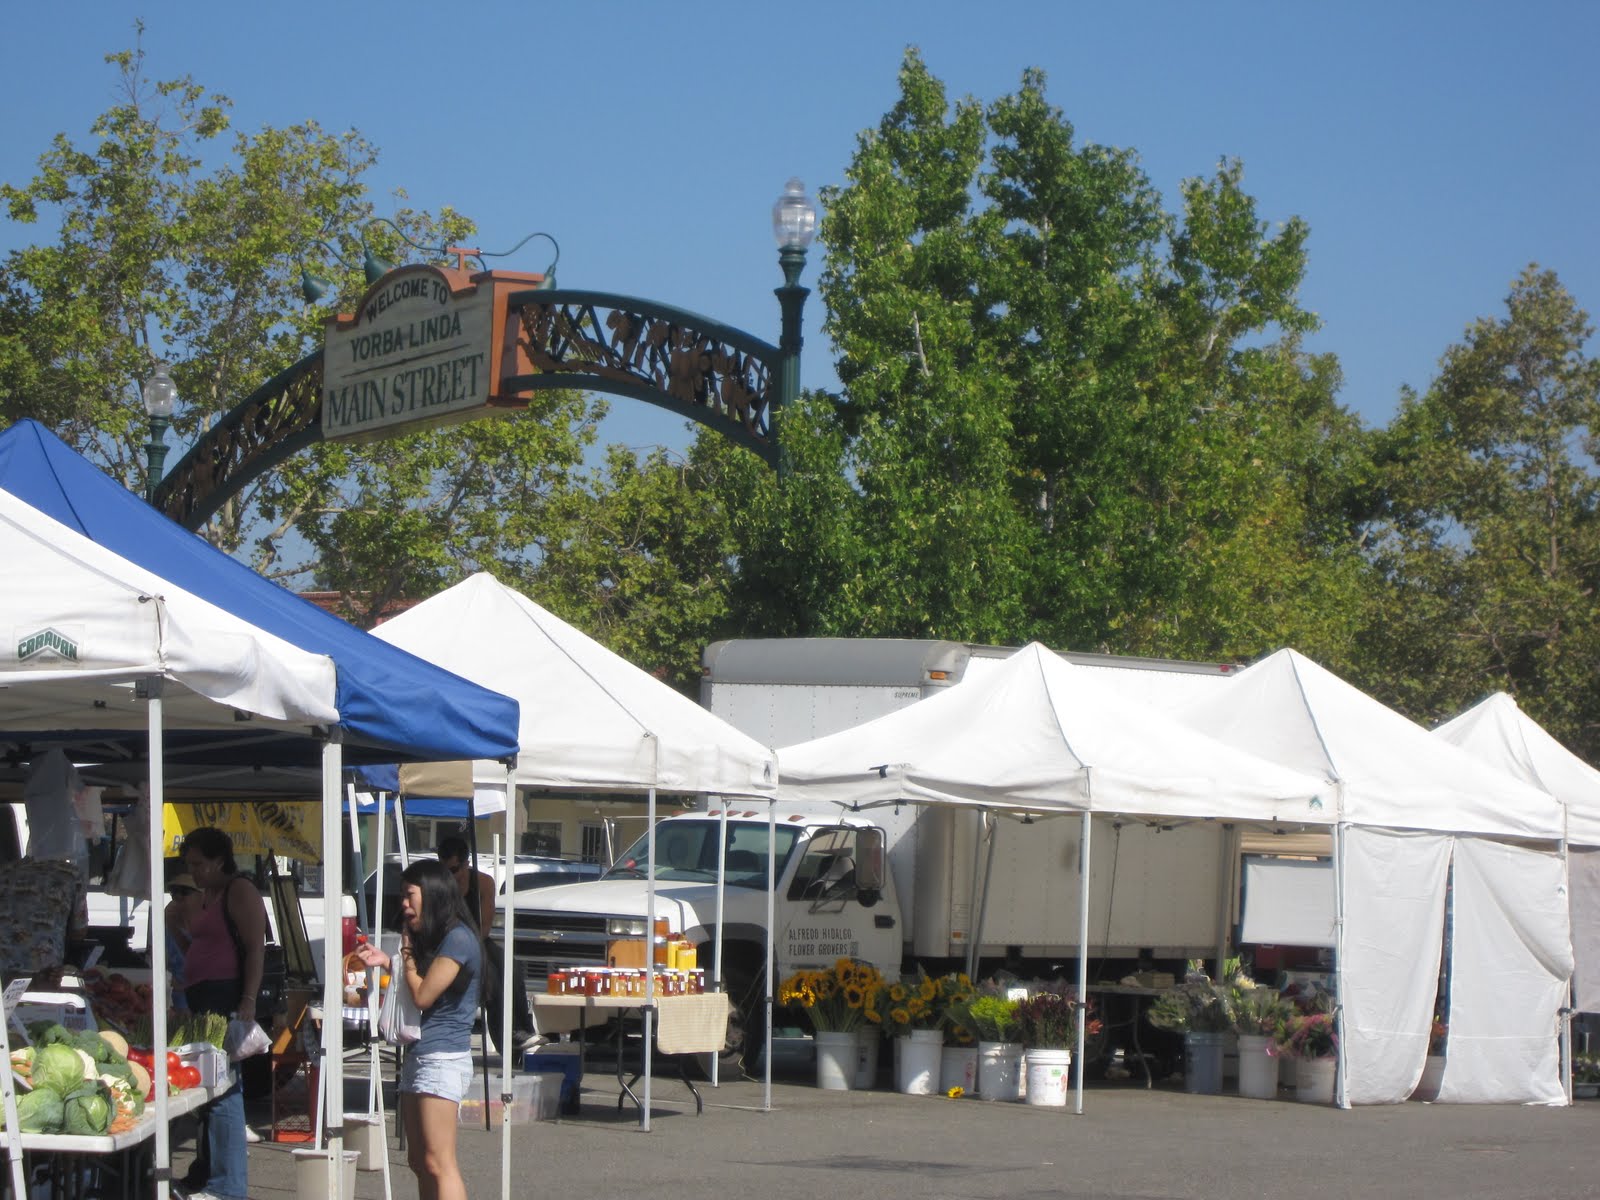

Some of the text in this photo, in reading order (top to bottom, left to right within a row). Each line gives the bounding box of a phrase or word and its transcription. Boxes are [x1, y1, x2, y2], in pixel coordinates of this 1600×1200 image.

[366, 278, 448, 324] WELCOME TO
[350, 311, 463, 363] YORBA LINDA
[327, 352, 484, 429] MAIN STREET
[18, 630, 78, 660] CARAVAN
[789, 928, 852, 940] ALFREDO HIDALGO
[789, 944, 815, 956] FLOWER
[818, 943, 848, 956] GROWERS
